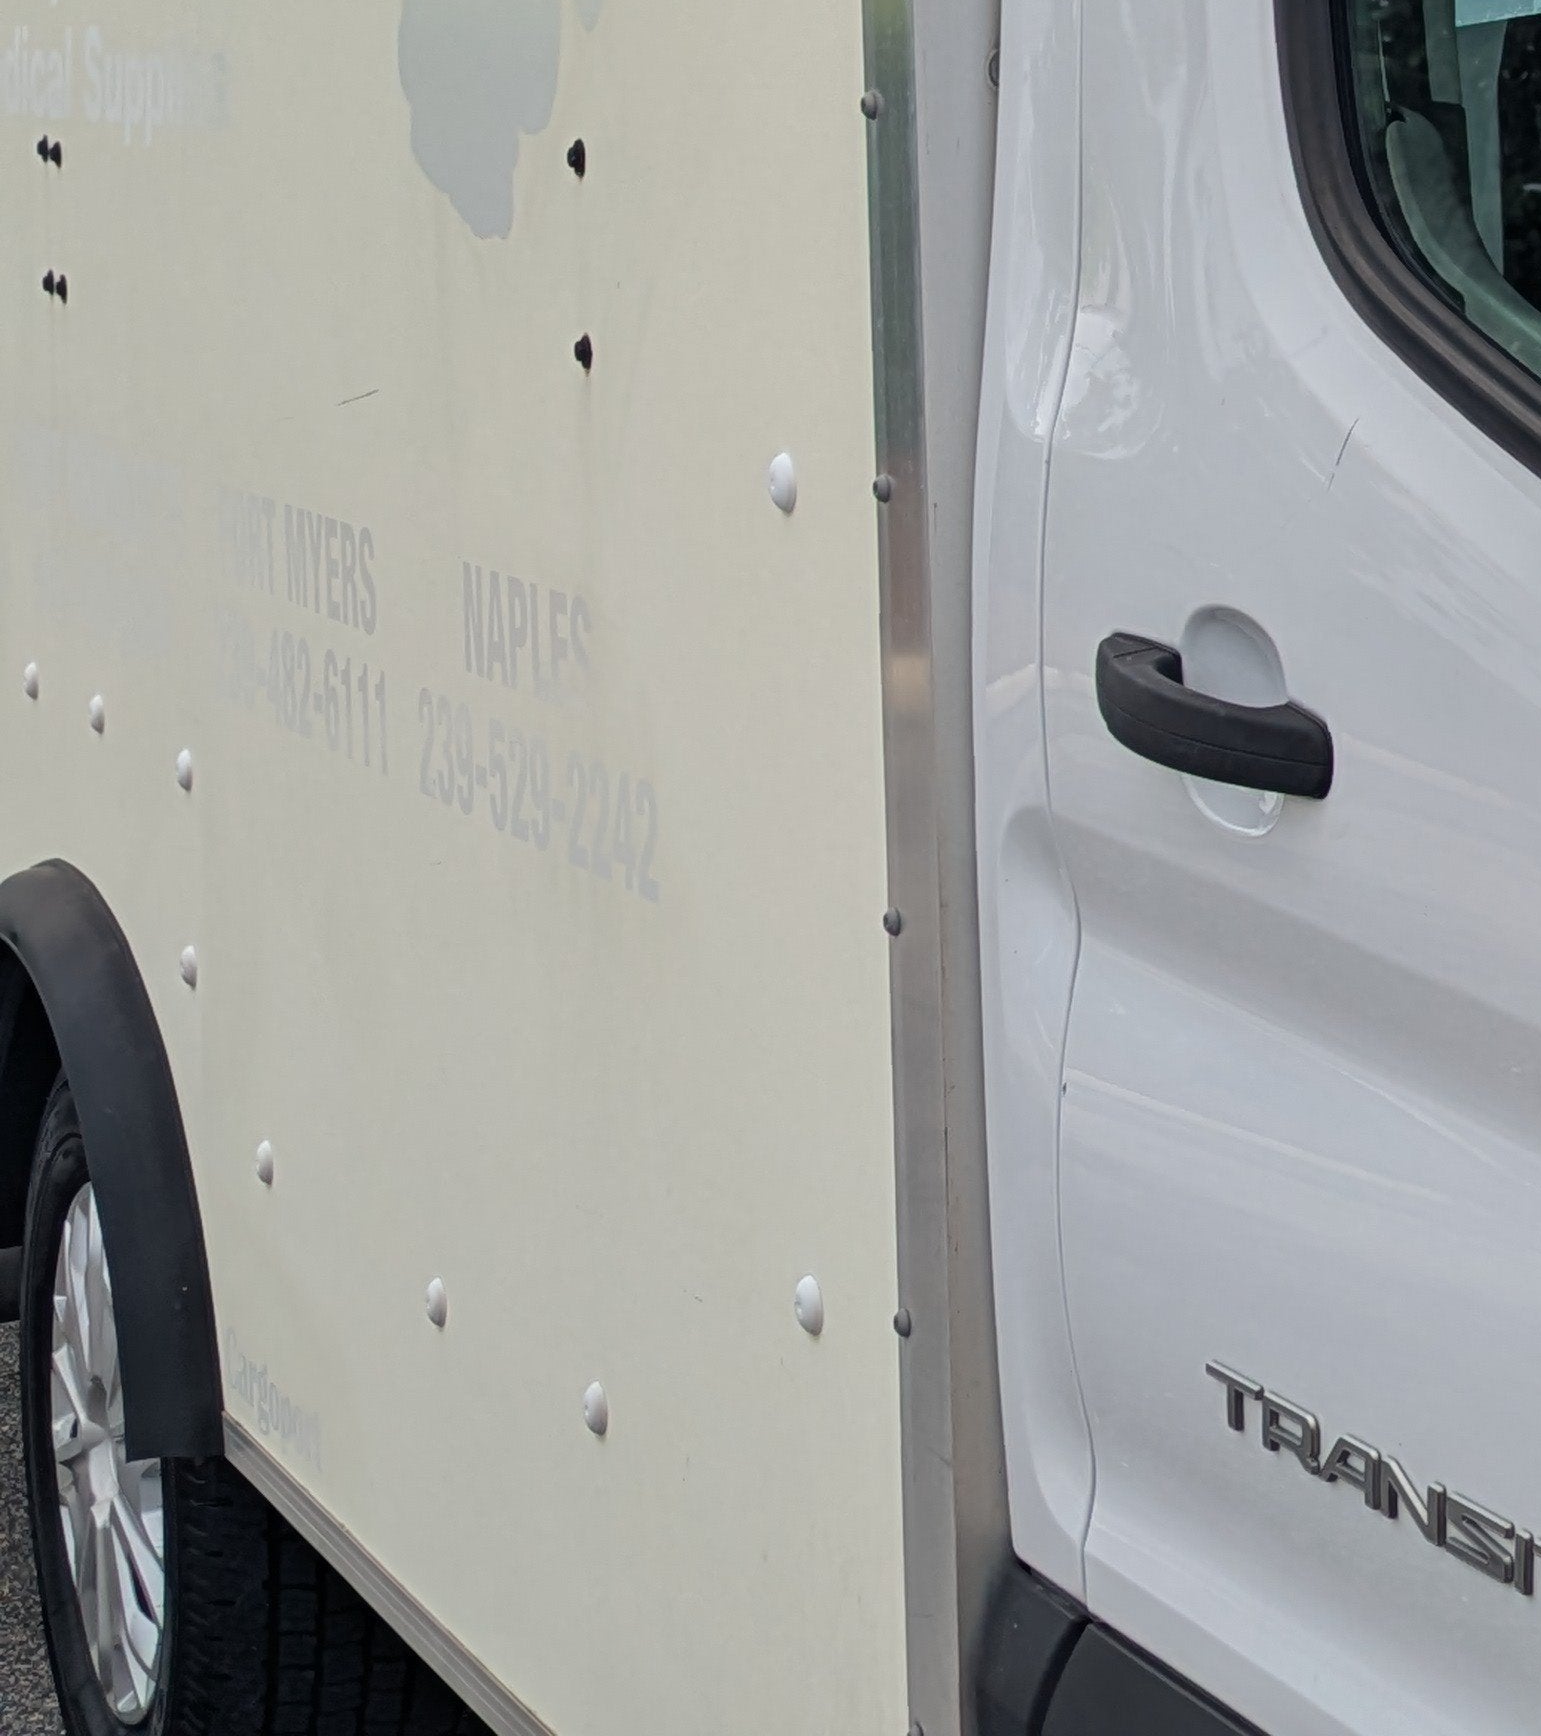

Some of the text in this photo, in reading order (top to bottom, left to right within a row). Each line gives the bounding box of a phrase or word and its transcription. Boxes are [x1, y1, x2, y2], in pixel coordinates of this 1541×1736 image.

[284, 503, 378, 636] MYERS
[461, 560, 595, 712] NAPLES
[417, 686, 661, 905] 239-529-2242
